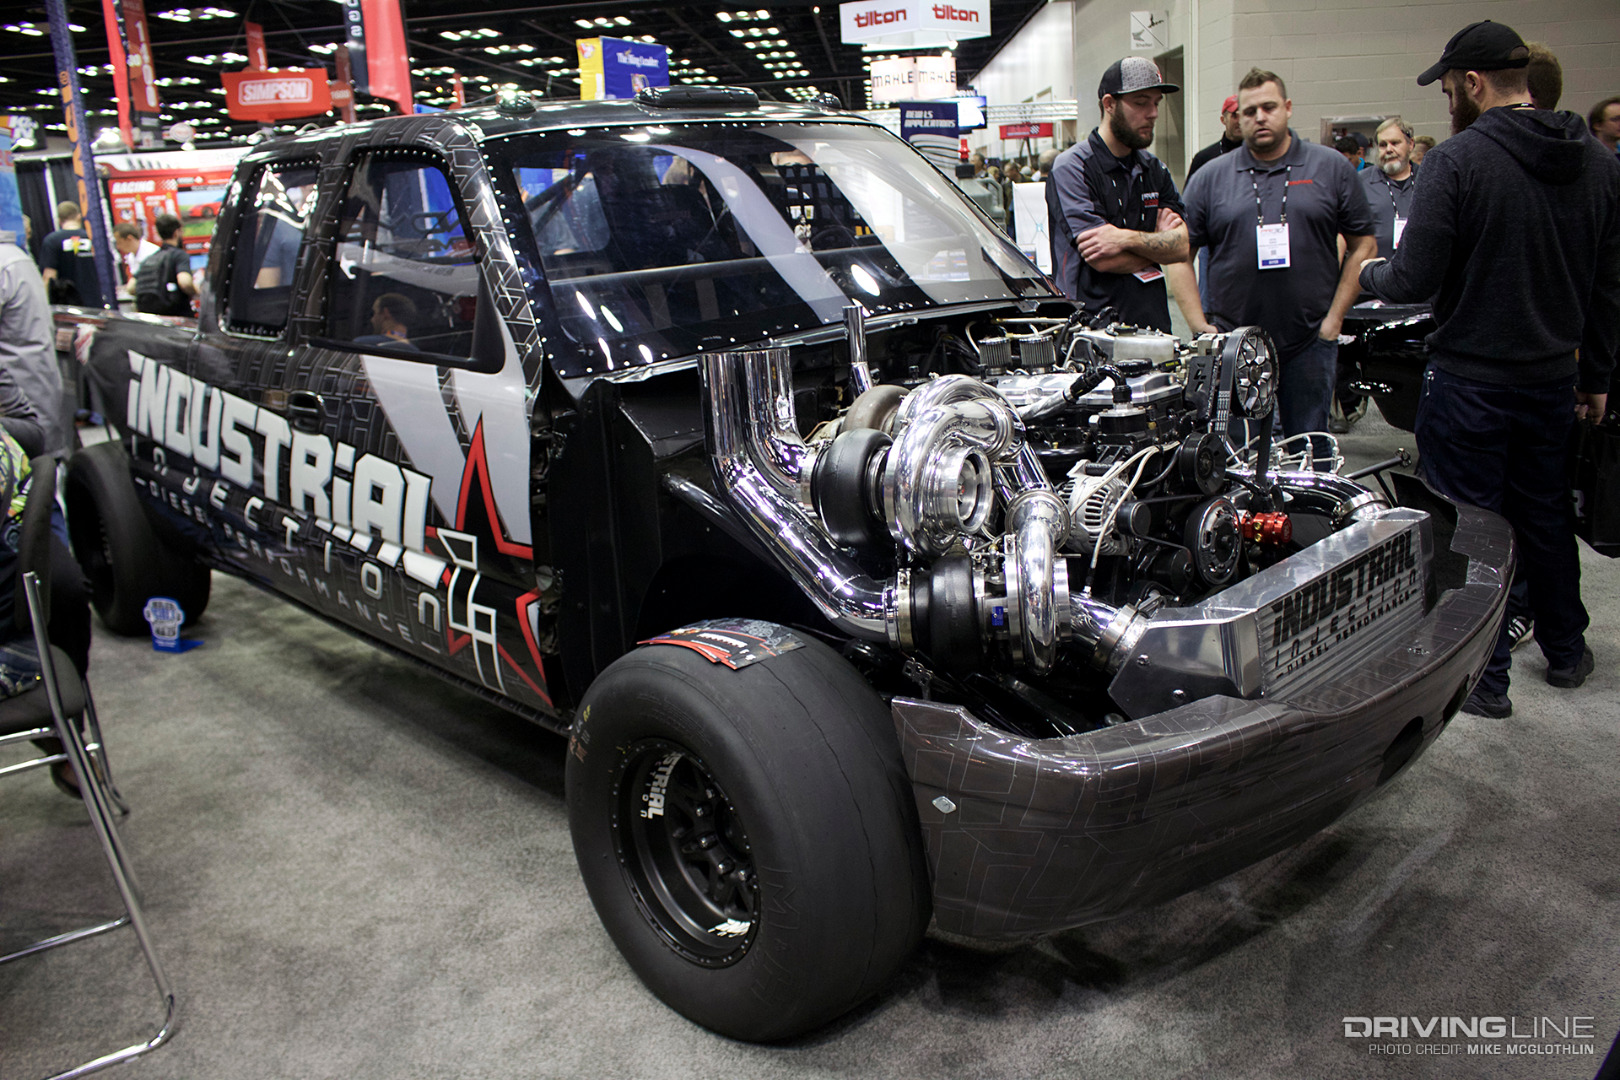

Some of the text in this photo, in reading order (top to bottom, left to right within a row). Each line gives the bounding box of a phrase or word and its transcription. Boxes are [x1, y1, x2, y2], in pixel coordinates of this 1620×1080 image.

[854, 9, 907, 28] tilton
[932, 3, 979, 23] tilton
[873, 71, 914, 88] MAHLE
[919, 70, 957, 84] MAHLE
[243, 82, 308, 101] SIMPSON
[904, 119, 956, 129] APPLICATIONS
[112, 180, 155, 195] RACING
[1286, 591, 1411, 676] DIESEL PERFORMANCE
